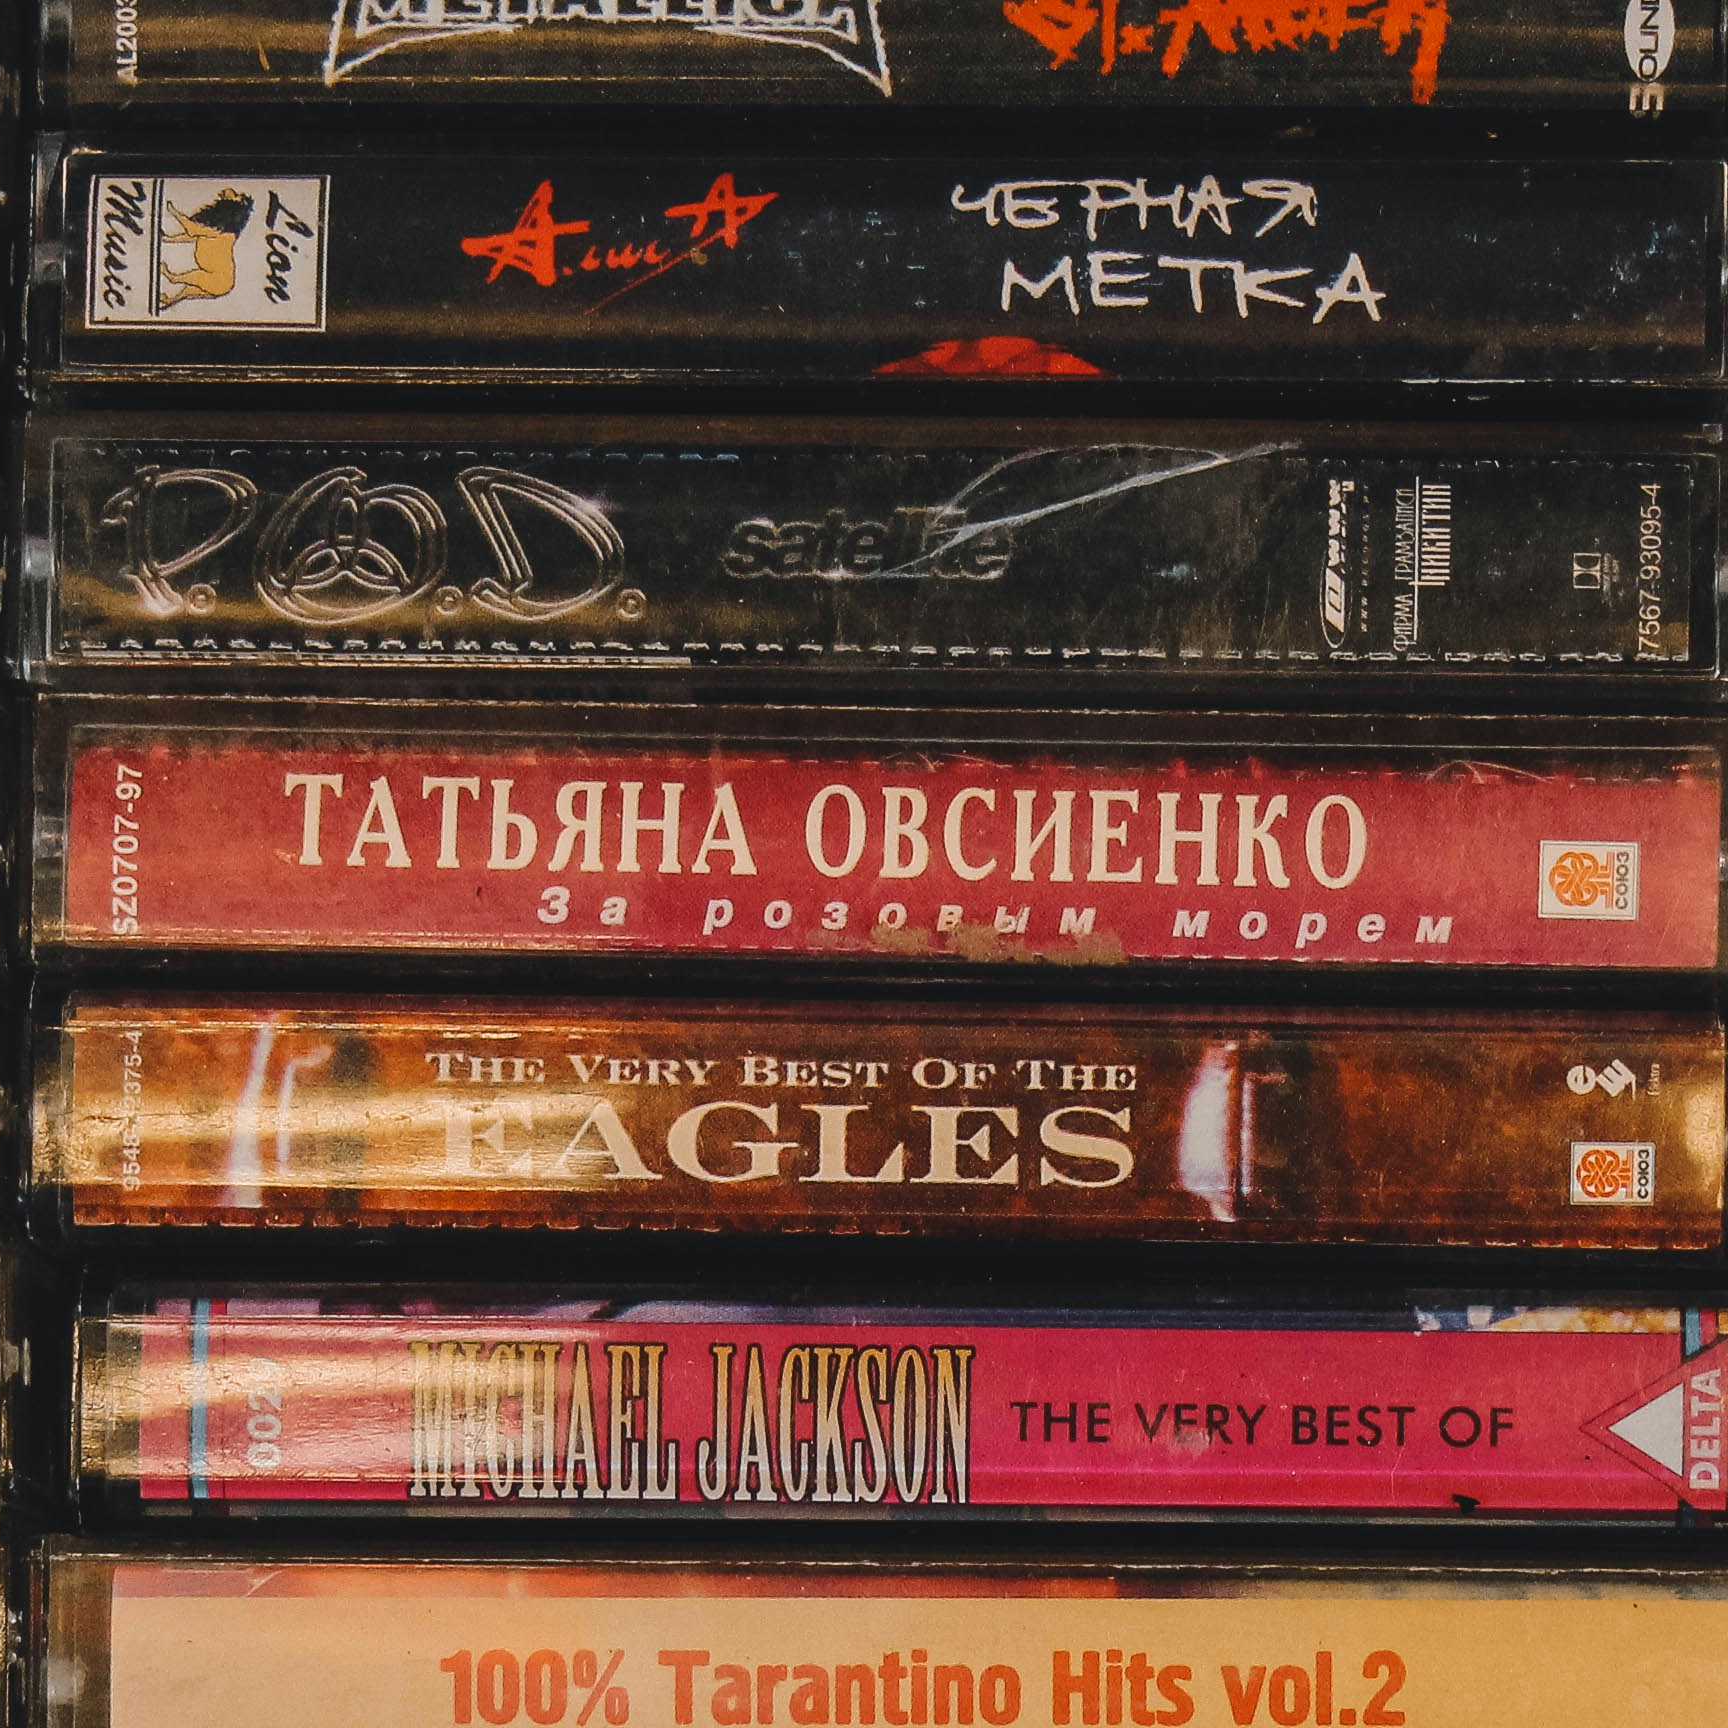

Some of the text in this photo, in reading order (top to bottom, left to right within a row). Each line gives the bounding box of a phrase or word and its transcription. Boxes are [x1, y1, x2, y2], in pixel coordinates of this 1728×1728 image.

[950, 175, 1317, 240] ЧЕРНАЯ
[1001, 251, 1387, 324] МЕТКА
[1419, 483, 1451, 586] НИКИТИН
[114, 765, 144, 936] SZ0707-97
[284, 773, 1368, 890] ТАТЬЯНА ОВСИЕНКО
[538, 887, 1453, 948] За розовым морем
[1615, 852, 1629, 912] СОЮЗ
[425, 1050, 1137, 1093] THE VERY BEST OF THE
[439, 1099, 1136, 1188] EAGLES
[407, 1343, 1514, 1503] MICHAEL JACKSON THE VERY BEST OF
[1688, 1367, 1722, 1492] DELTA
[441, 1649, 1407, 1727] 100% Tarantino Hits vol.2
